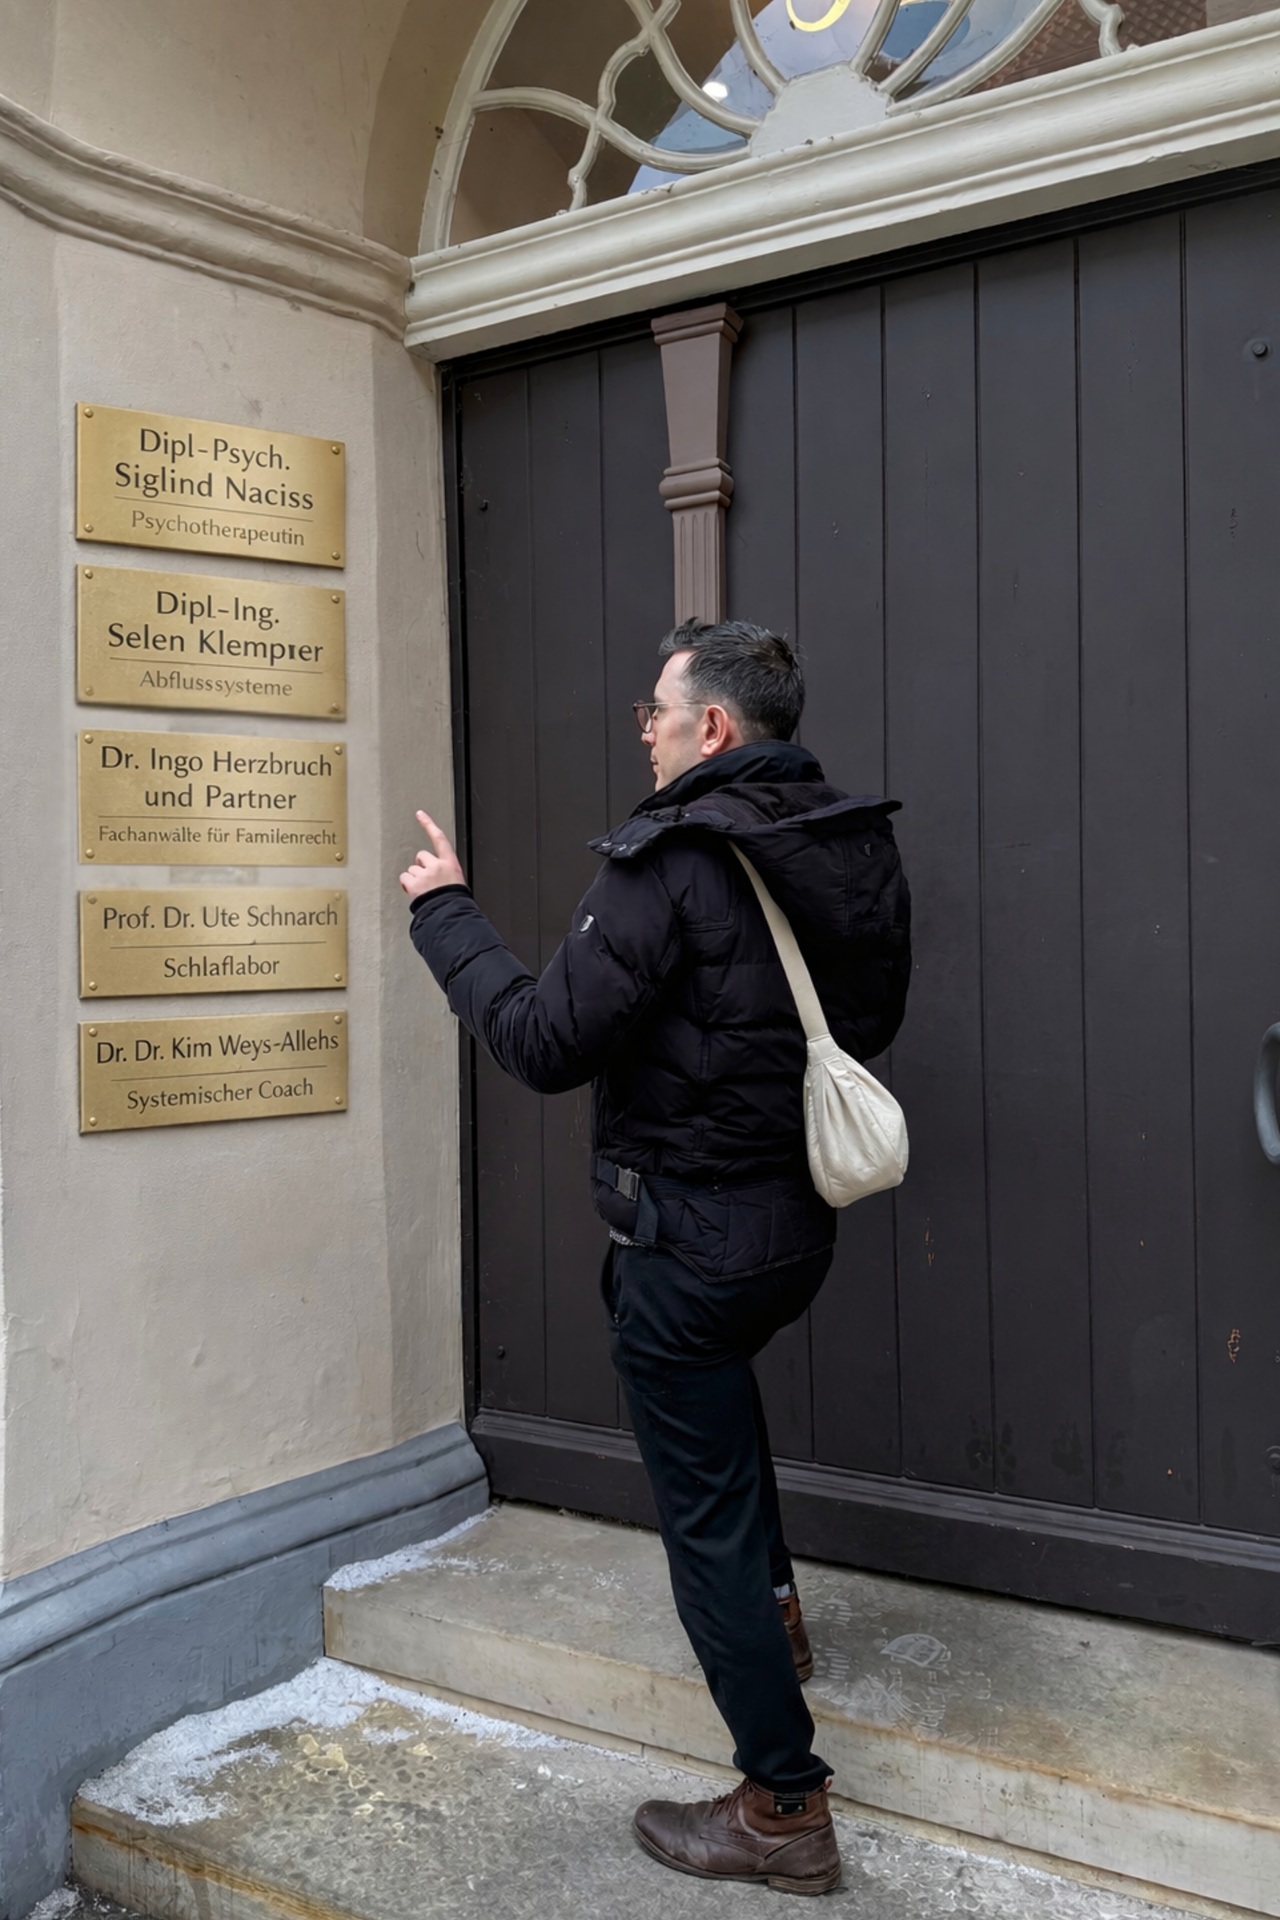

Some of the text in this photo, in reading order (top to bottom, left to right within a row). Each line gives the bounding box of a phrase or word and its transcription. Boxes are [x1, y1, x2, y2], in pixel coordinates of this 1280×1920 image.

[140, 428, 291, 472] Dipl-Psych.
[115, 461, 314, 510] Siglind Naciss
[131, 510, 305, 546] Psychotherapeutin
[108, 622, 185, 652] Selen
[139, 670, 293, 698] Abflusssysteme
[101, 745, 333, 779] Dr. Ingo Herzbruch
[144, 783, 297, 810] und Partner
[207, 827, 230, 843] für
[103, 903, 338, 930] Prof. Dr. Ute Schnarch
[163, 954, 281, 979] Schlaflabor
[96, 1028, 339, 1064] Dr. Dr. Kim Weys-Allehs
[127, 1077, 313, 1115] Systemischer Coach
